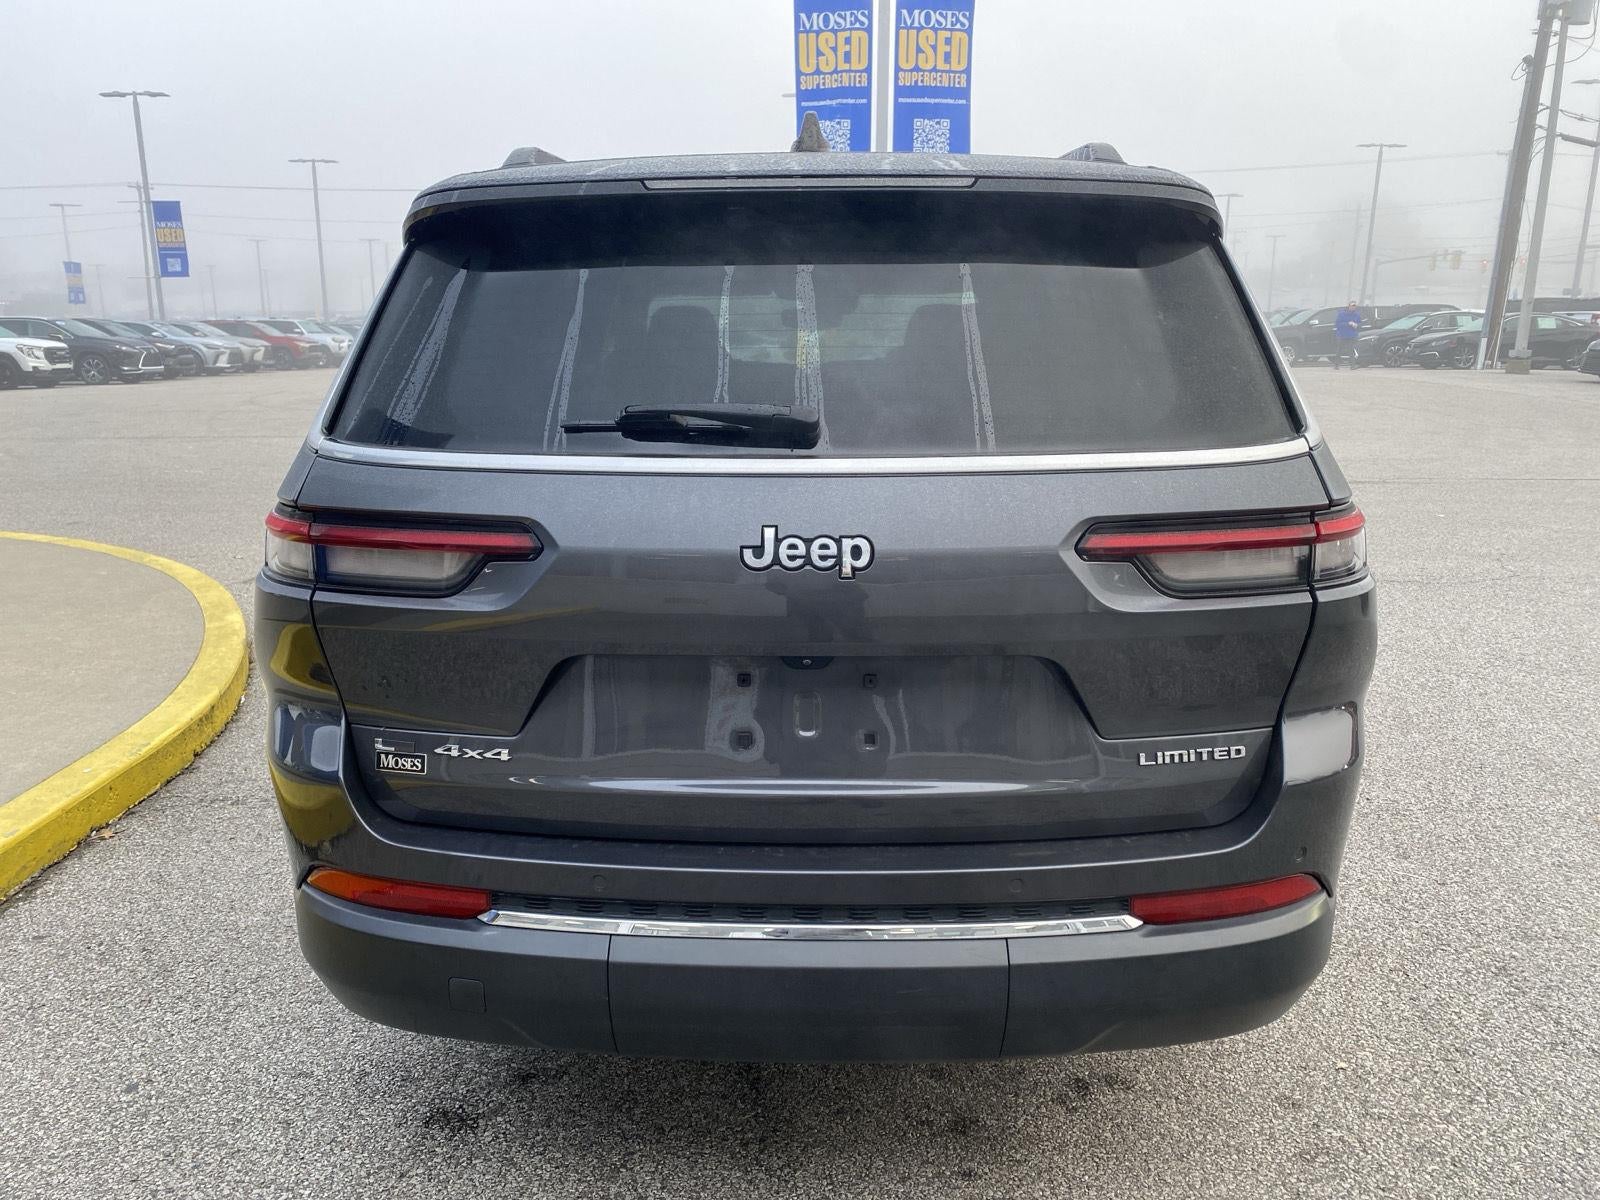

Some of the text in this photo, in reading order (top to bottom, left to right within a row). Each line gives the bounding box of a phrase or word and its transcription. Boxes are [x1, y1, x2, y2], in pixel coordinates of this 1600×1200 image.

[799, 10, 869, 31] MOSES
[901, 9, 970, 29] MOSES
[798, 31, 869, 73] USED
[898, 29, 969, 71] USED
[800, 72, 867, 90] SUPERCENTER
[898, 71, 967, 88] SUPERCENTER
[156, 228, 185, 243] USED
[741, 525, 874, 579] Jeep
[379, 753, 422, 771] MOSES
[433, 744, 513, 761] 4x4
[1139, 746, 1246, 766] LIMITED
